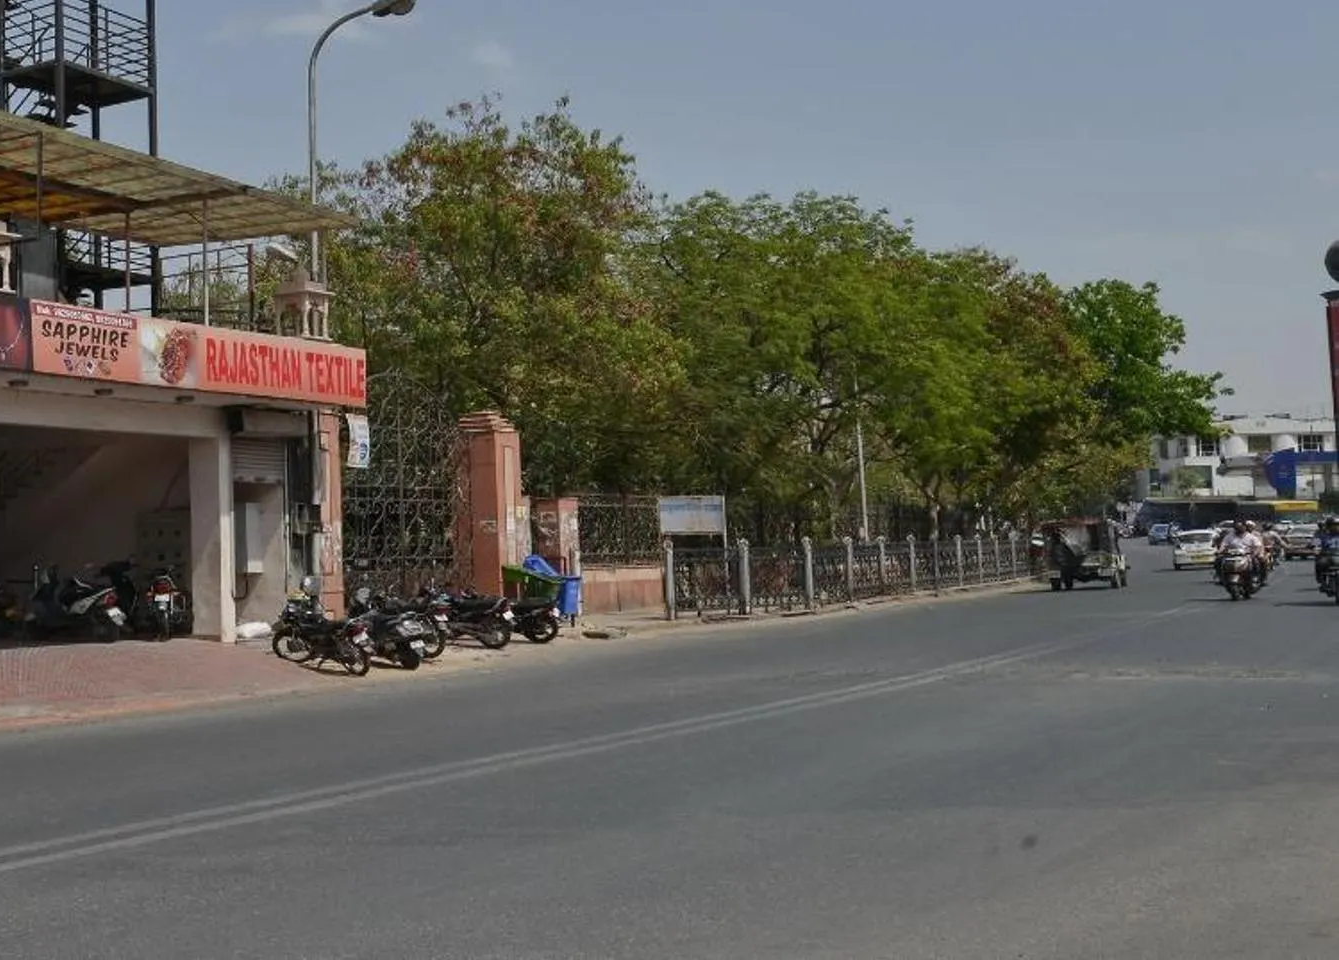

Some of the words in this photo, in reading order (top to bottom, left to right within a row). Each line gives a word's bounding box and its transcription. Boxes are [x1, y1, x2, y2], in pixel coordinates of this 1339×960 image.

[42, 320, 129, 348] SAPPHIRE
[55, 341, 119, 362] JEWELS
[205, 338, 302, 390] RAJASTHAN
[305, 351, 365, 398] TEXTILE
